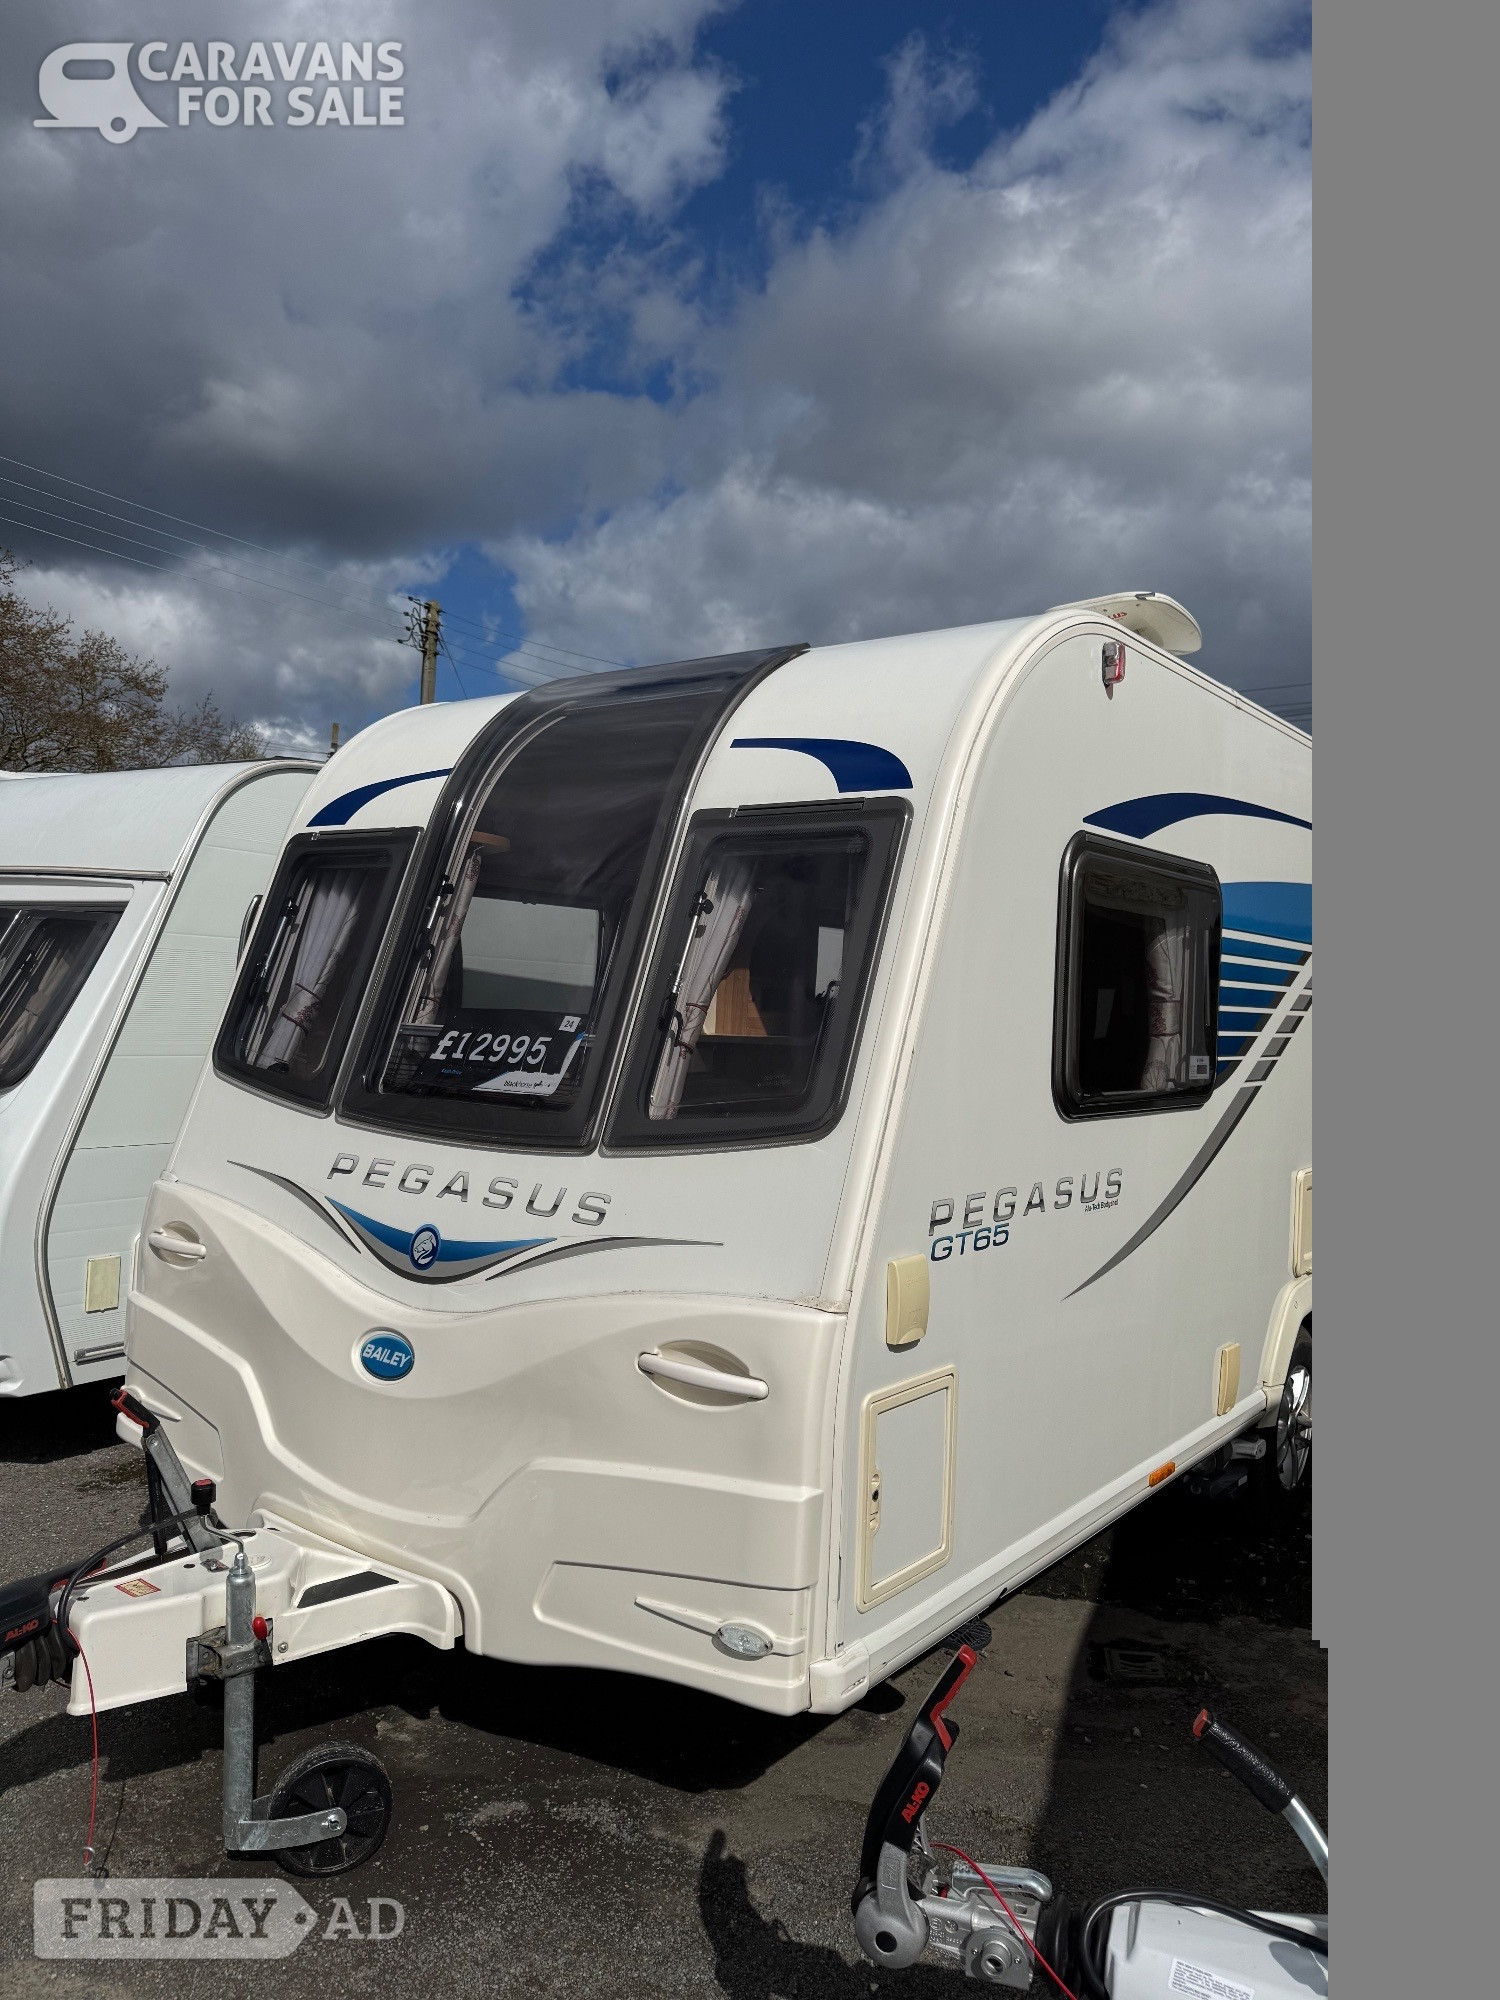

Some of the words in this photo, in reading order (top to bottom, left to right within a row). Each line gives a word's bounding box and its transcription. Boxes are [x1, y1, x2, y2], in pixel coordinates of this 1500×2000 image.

[562, 1019, 575, 1029] 24
[429, 1030, 552, 1065] £12995
[326, 1152, 612, 1227] PEGASUS
[928, 1167, 1123, 1237] PEGASUS
[930, 1222, 1010, 1262] GT65
[362, 1343, 412, 1368] BAILEY
[4, 1619, 39, 1642] AL-KO
[901, 1781, 930, 1824] AL-KO
